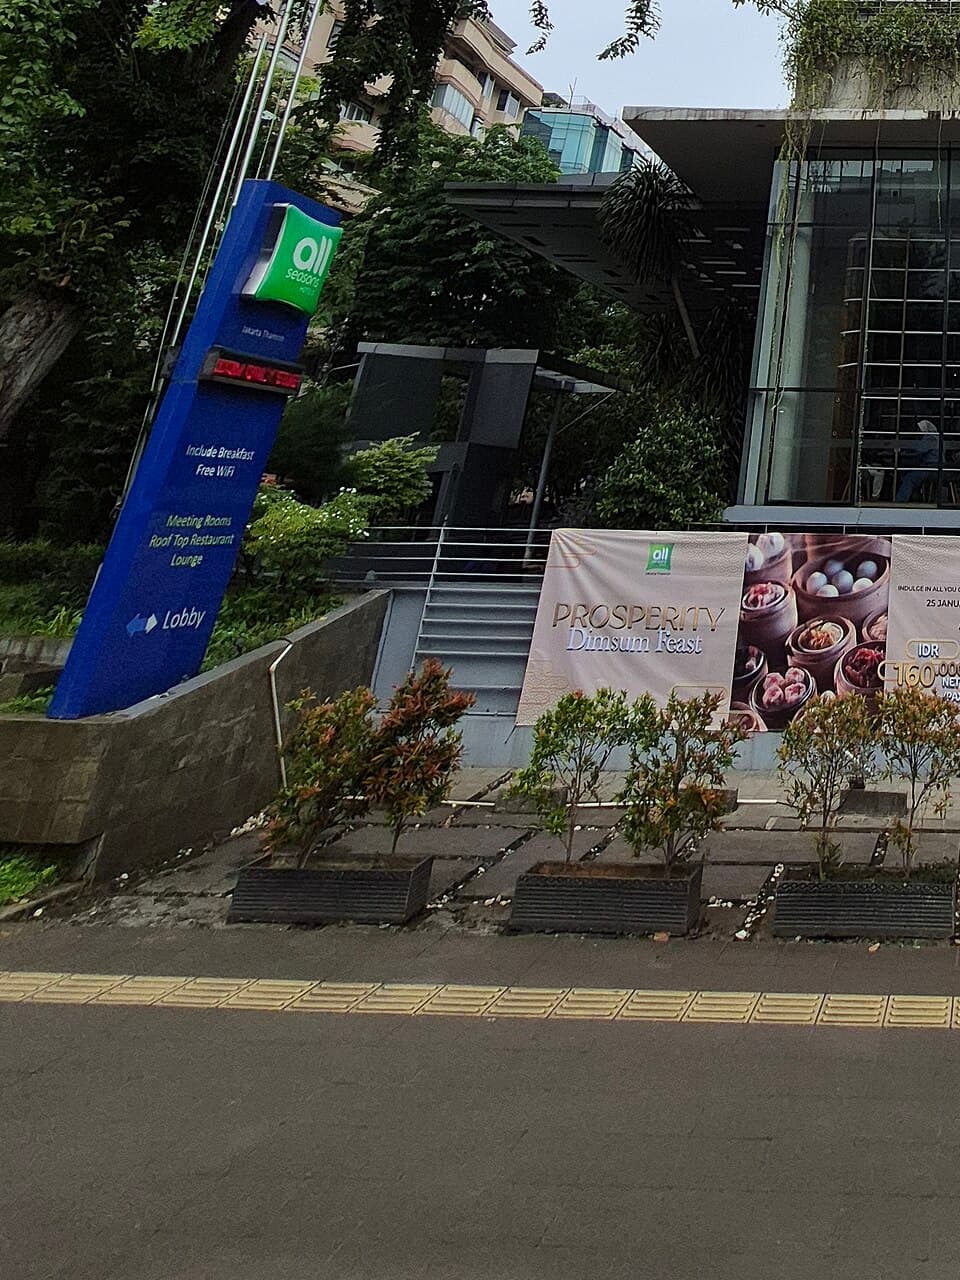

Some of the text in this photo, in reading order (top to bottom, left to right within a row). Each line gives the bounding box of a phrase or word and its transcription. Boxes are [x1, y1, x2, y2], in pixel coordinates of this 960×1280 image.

[292, 235, 333, 277] all
[285, 268, 320, 288] seasons
[186, 444, 255, 461] Include Breakfast
[195, 464, 235, 477] Free WiFi
[166, 514, 232, 529] Meeting Rooms
[149, 533, 235, 548] Roof Top Restaurant
[170, 553, 203, 567] Lounge
[652, 547, 669, 560] all
[926, 599, 936, 607] 25
[162, 606, 206, 631] Lobby
[552, 603, 726, 632] PROSPERITY
[566, 628, 703, 654] Dimsum Feast
[917, 643, 940, 658] IDR
